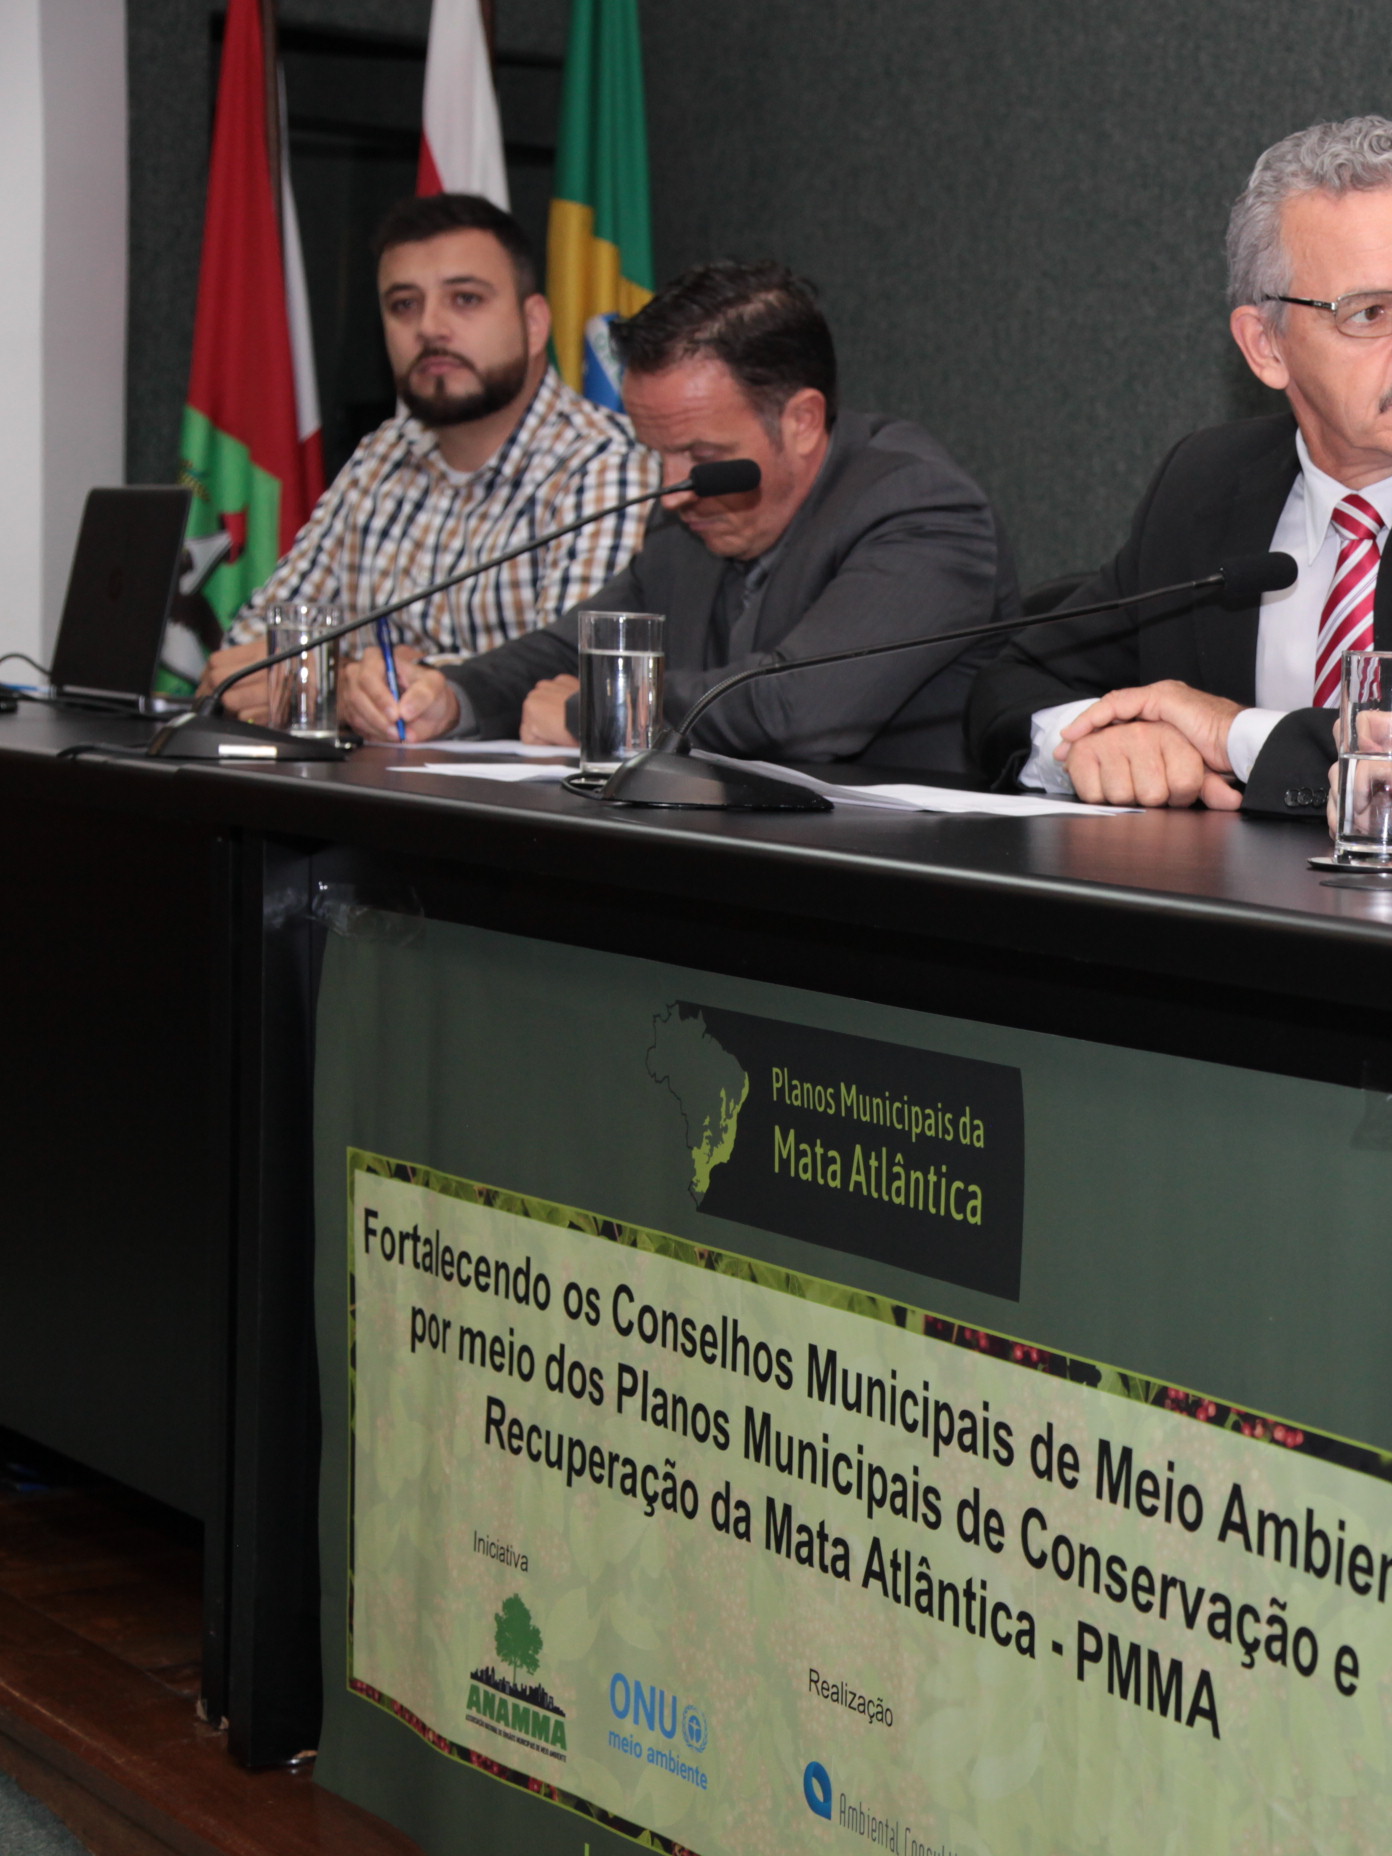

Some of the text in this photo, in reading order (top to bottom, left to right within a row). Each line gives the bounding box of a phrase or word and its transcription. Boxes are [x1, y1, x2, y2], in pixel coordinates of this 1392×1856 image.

[772, 1067, 984, 1148] Planos Municipais da
[774, 1125, 982, 1225] Mata Atlântica
[365, 1207, 550, 1311] Fortalecendo
[562, 1280, 600, 1326] os
[613, 1284, 793, 1391] Conselhos
[807, 1344, 1014, 1467] Municipais
[1030, 1423, 1080, 1489] de
[1096, 1438, 1203, 1532] Meio
[410, 1306, 1359, 1697] por meio dos Planos Municipais de Conservação e
[473, 1530, 529, 1573] Iniciativa
[485, 1396, 699, 1520] Recuperação
[711, 1482, 751, 1542] da
[764, 1497, 850, 1581] Mata
[863, 1536, 1036, 1659] Atlântica
[1077, 1620, 1221, 1740] PMMA
[467, 1683, 567, 1751] ANAMMA
[609, 1673, 677, 1739] ONU
[809, 1668, 894, 1728] Realização
[608, 1730, 643, 1760] meio
[647, 1747, 708, 1790] ambiente
[839, 1793, 900, 1856] Ambiental
